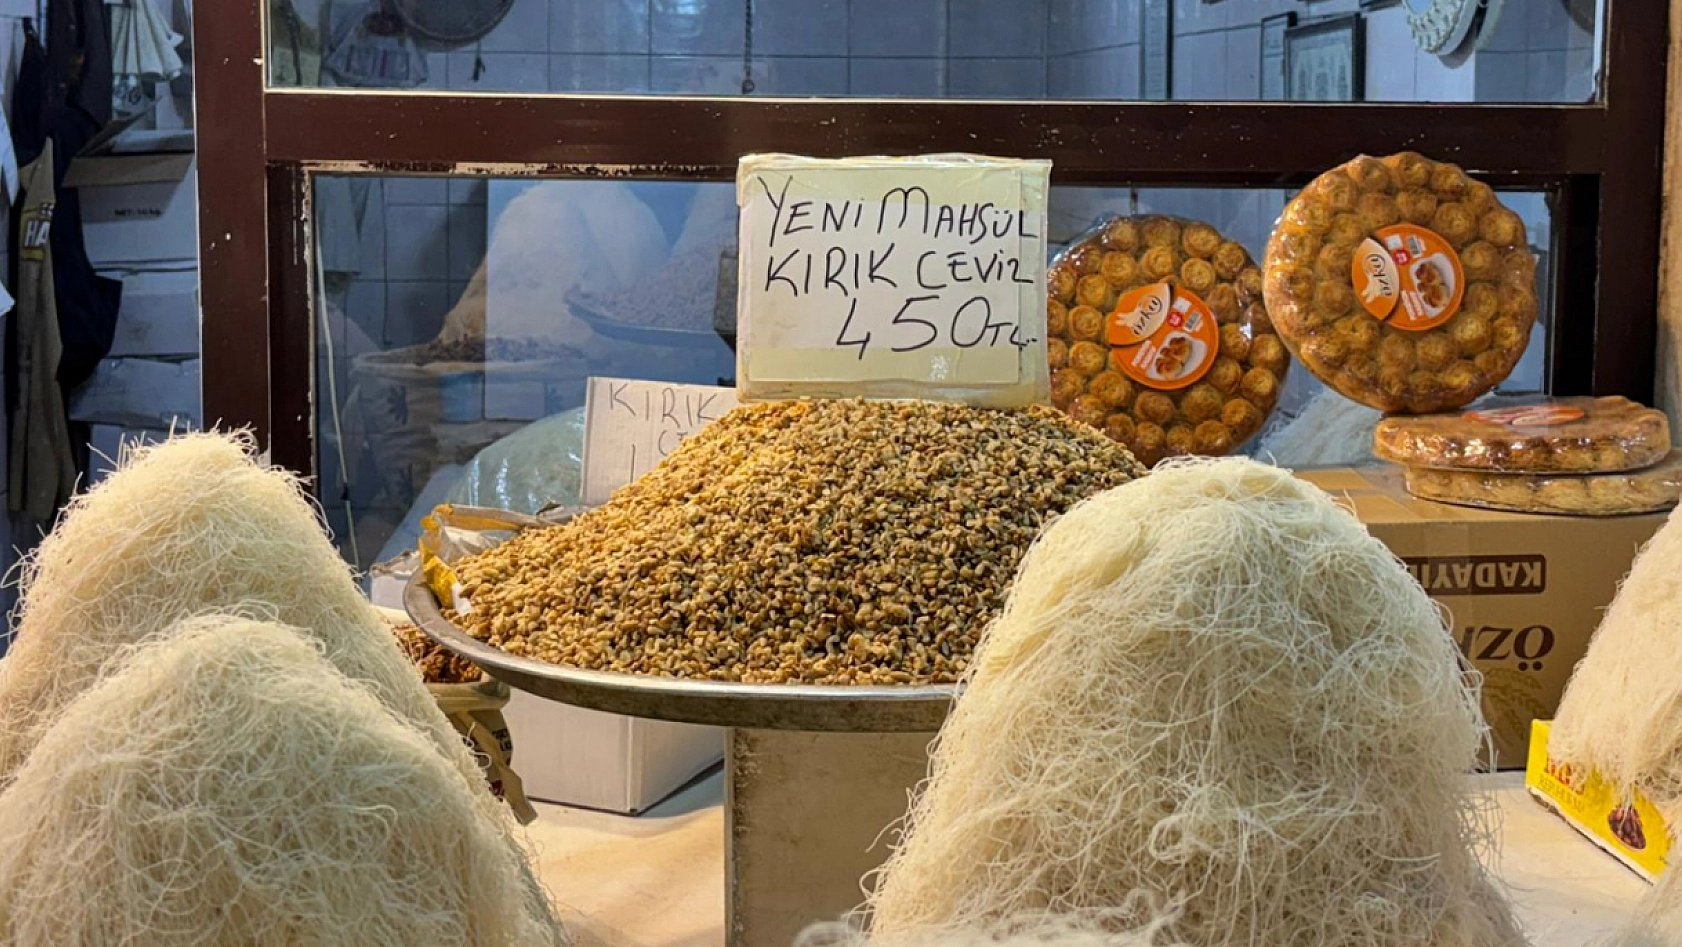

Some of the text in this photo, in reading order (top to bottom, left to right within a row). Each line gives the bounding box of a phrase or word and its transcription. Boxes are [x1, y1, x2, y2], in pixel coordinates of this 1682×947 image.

[877, 186, 1038, 244] MAHSÜL
[765, 243, 897, 296] KIRIK
[610, 382, 717, 428] KIRIK
